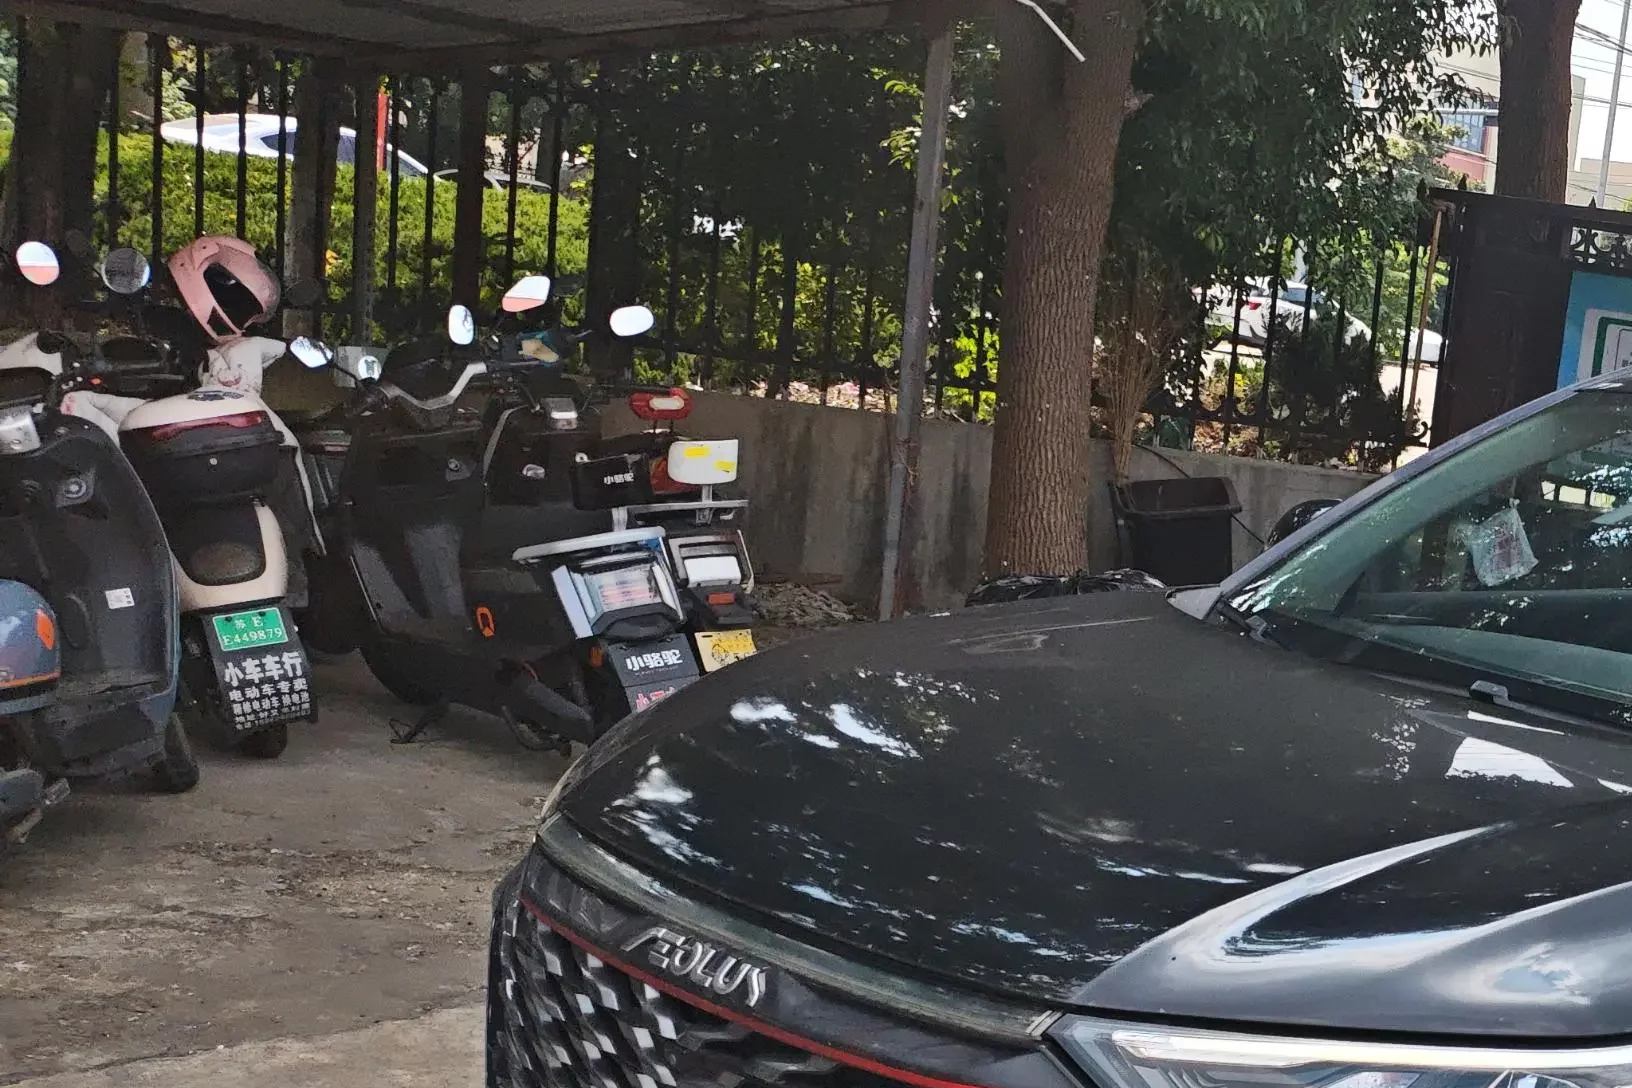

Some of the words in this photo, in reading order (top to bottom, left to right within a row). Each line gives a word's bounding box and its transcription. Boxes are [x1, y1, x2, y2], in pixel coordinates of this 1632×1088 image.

[251, 615, 264, 628] E
[222, 627, 283, 646] E449879
[223, 651, 303, 687] 小车车行
[625, 649, 684, 671] 小骆驼
[228, 677, 309, 702] 电动车专卖
[620, 926, 768, 1008] AEOLUS
